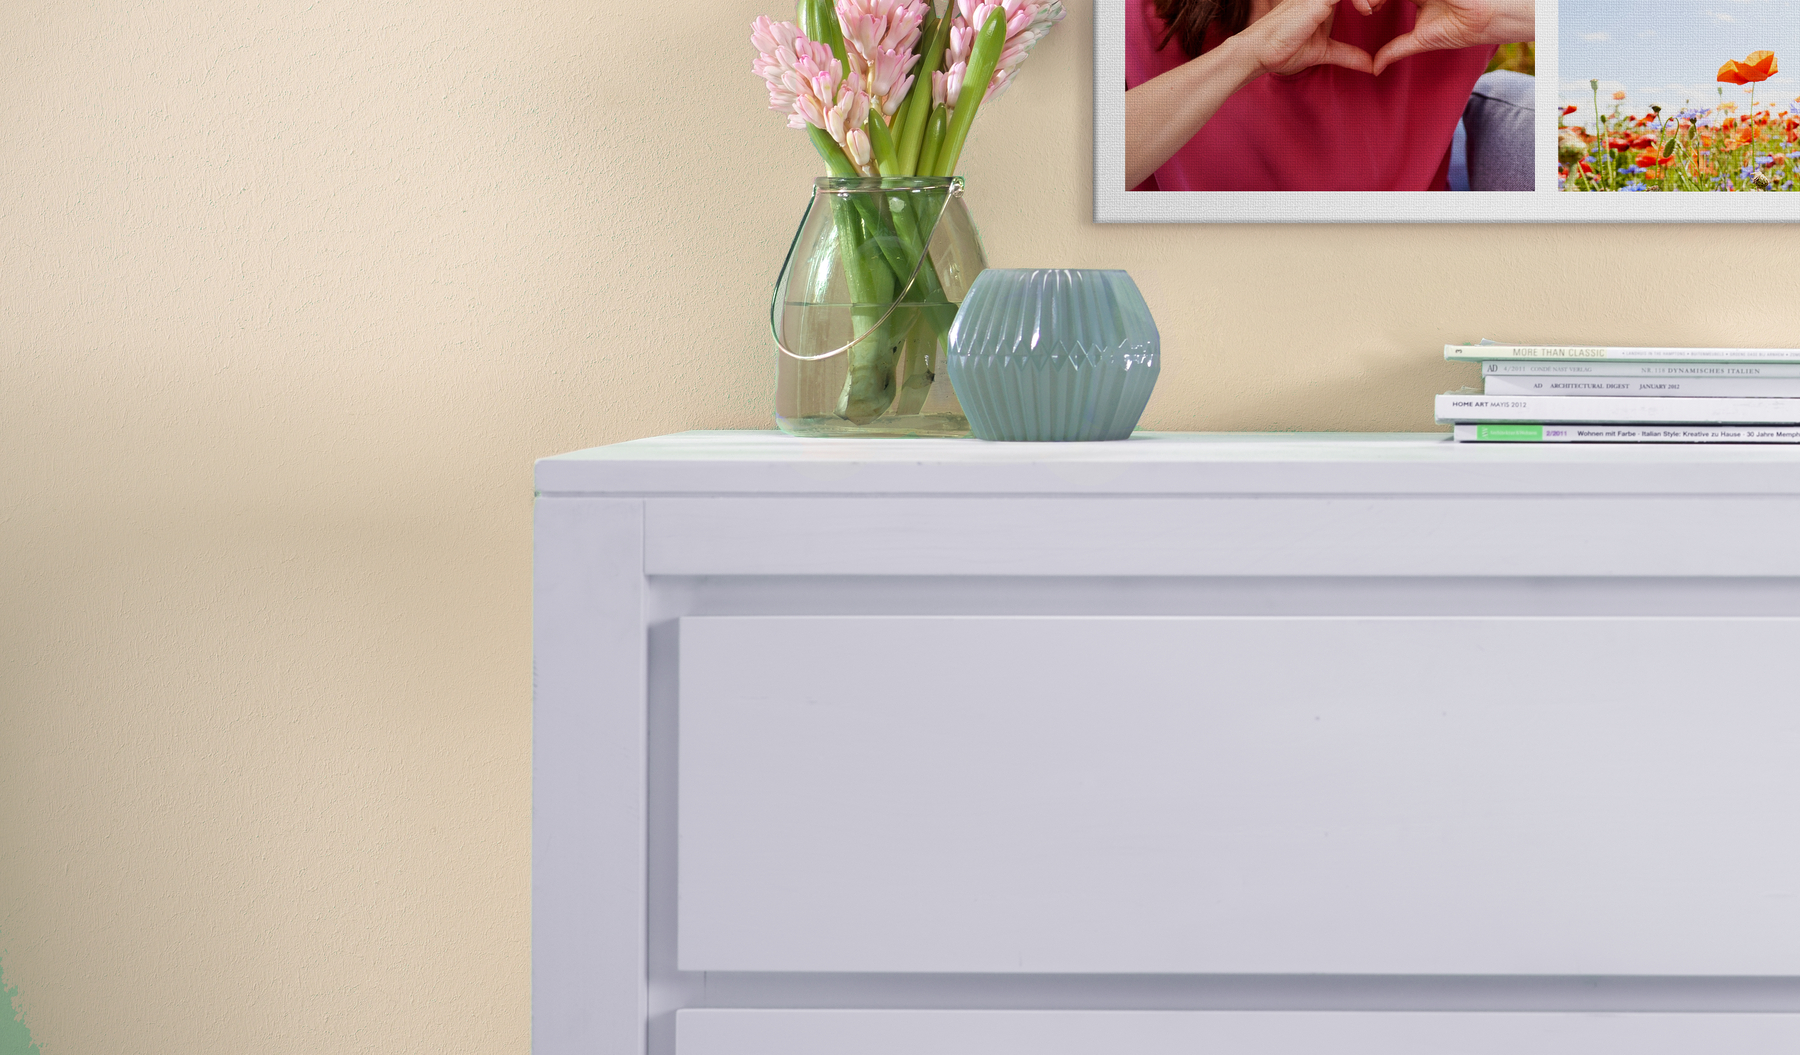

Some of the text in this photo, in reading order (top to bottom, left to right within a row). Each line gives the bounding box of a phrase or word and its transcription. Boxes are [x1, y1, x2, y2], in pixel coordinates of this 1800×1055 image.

[1513, 348, 1605, 357] MORE THAN CLASSIC
[1487, 364, 1498, 372] AD
